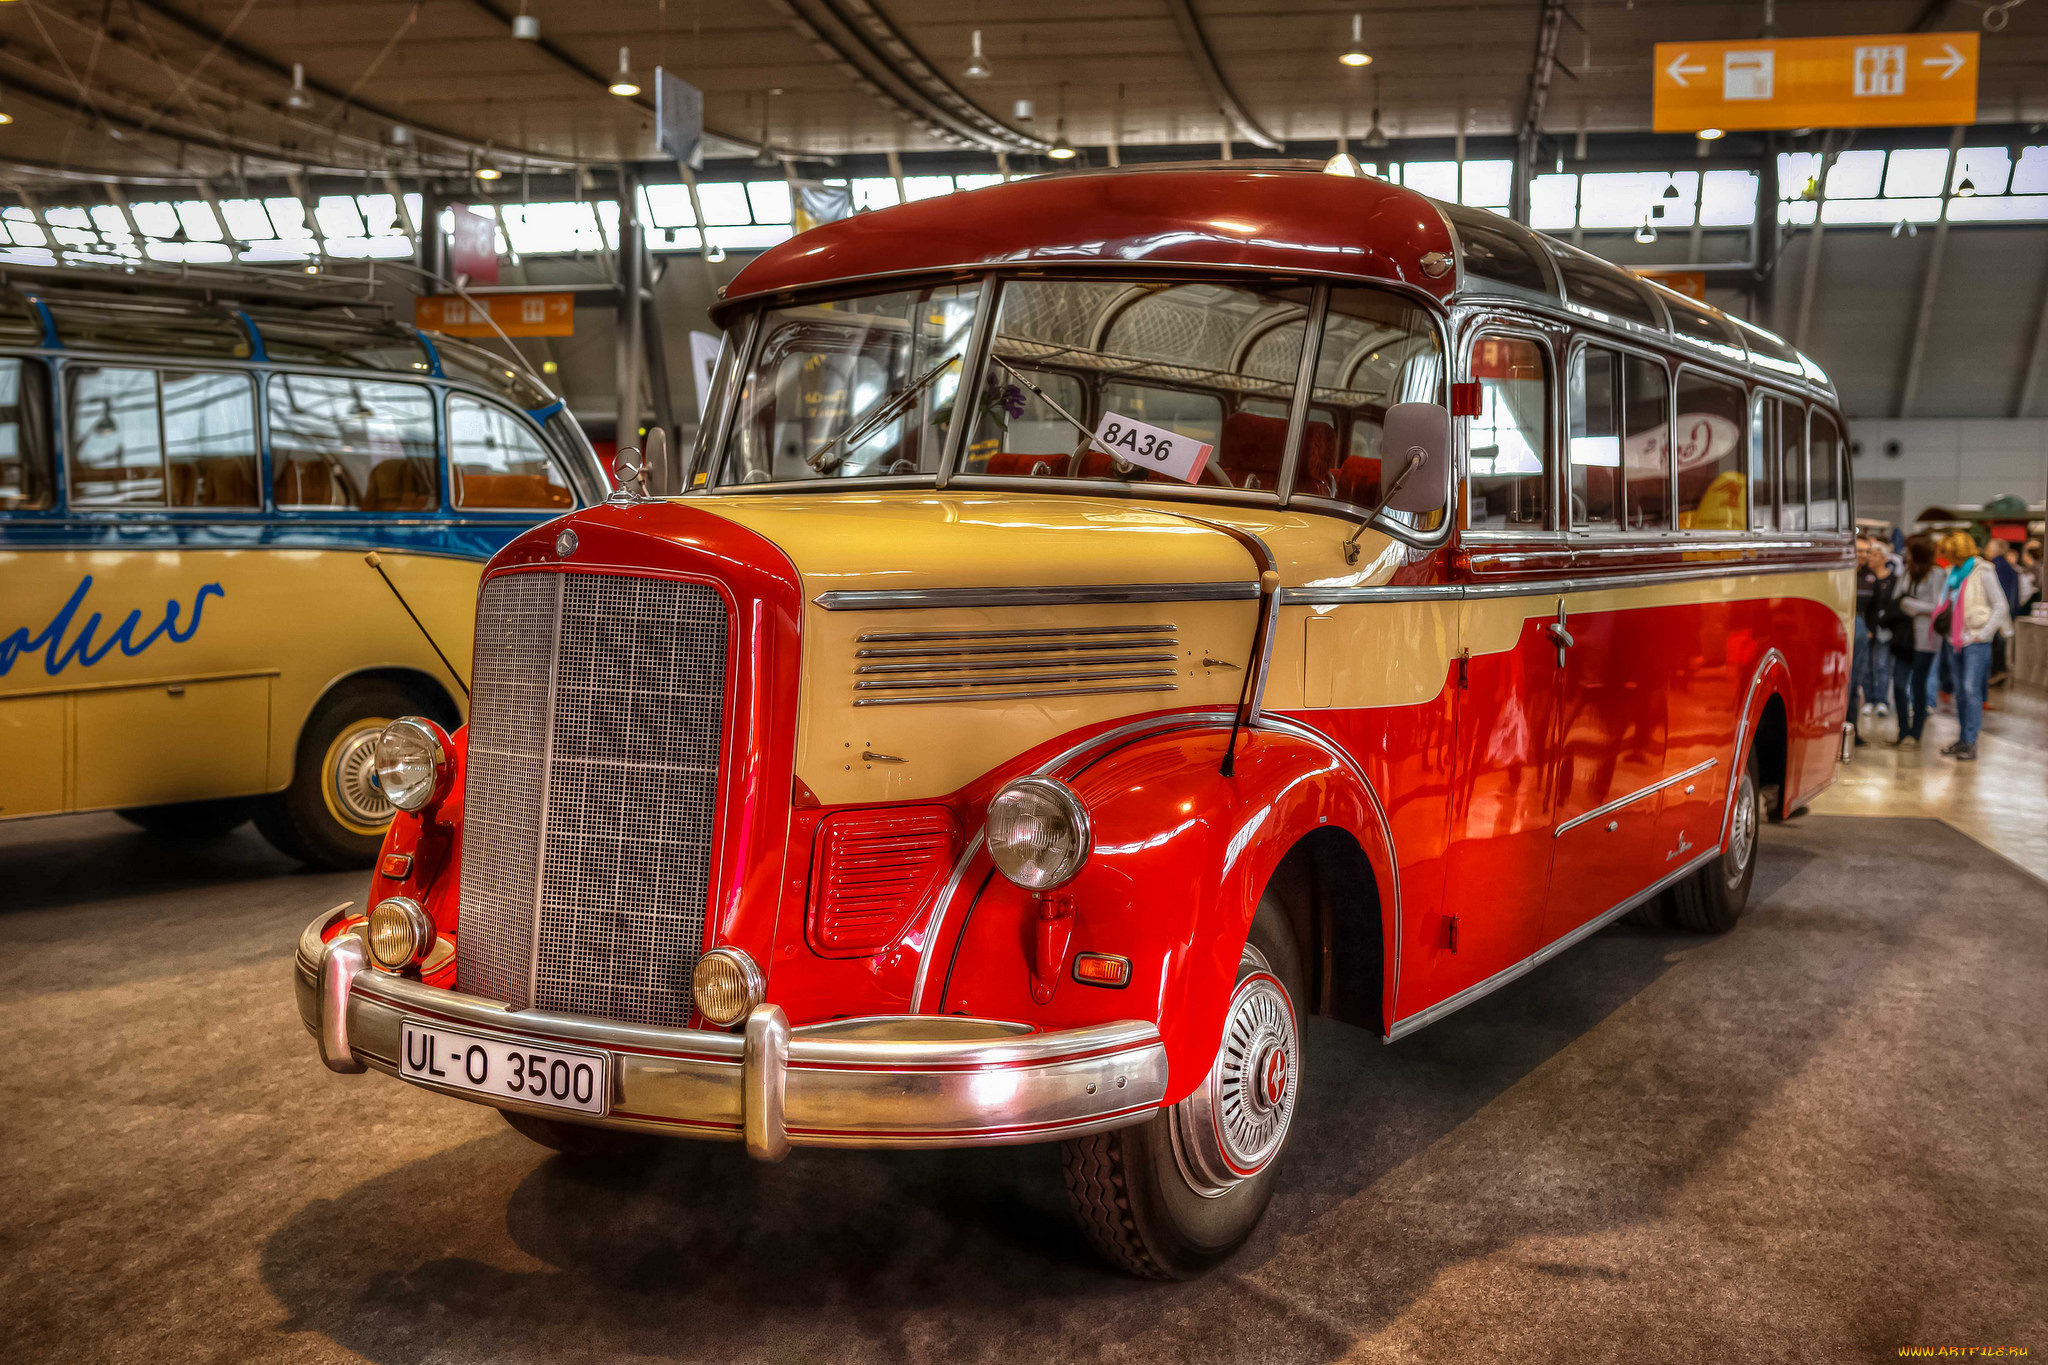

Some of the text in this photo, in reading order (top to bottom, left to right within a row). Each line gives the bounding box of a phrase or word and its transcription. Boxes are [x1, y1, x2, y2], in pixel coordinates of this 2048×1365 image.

[1103, 423, 1173, 461] 8A36
[408, 1031, 594, 1104] UL-O 3500
